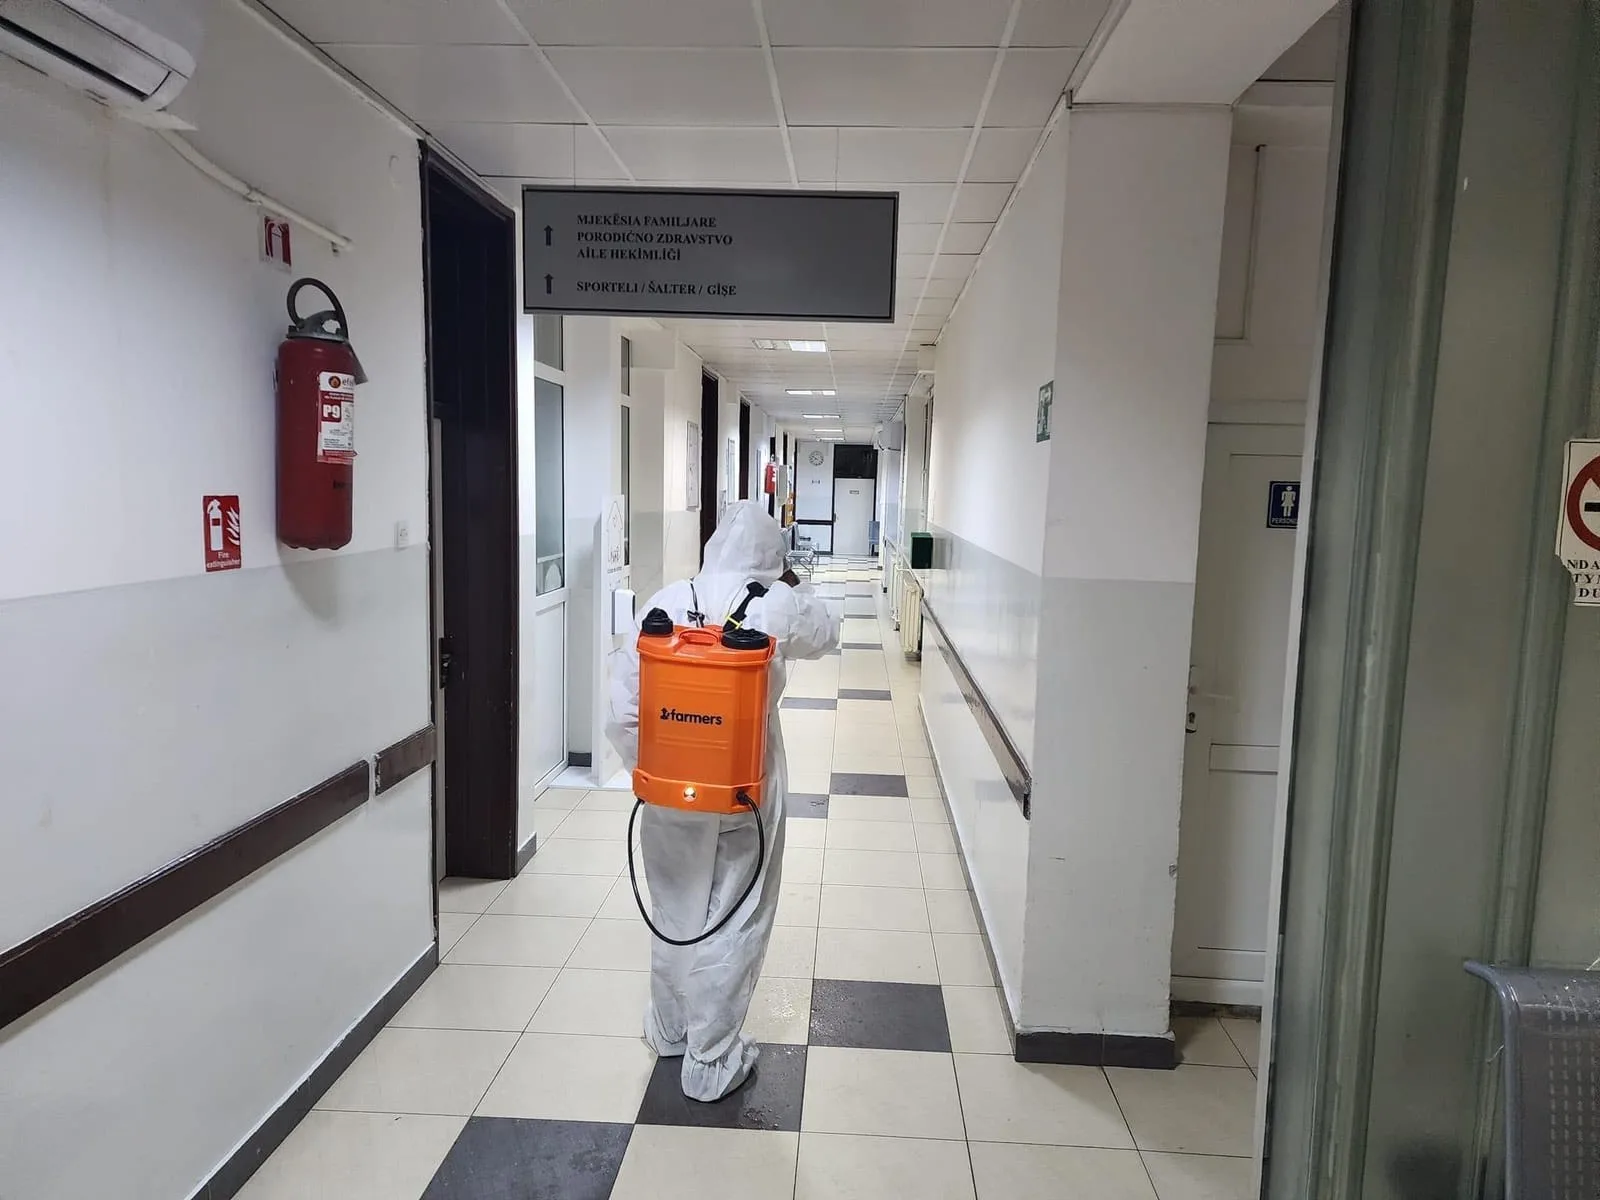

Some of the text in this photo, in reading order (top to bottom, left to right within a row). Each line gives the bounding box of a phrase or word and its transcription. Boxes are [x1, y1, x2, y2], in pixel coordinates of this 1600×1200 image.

[577, 213, 717, 228] MJEKËSIA FAMILJARE
[656, 233, 733, 245] ZDRAVSTVO
[577, 281, 638, 293] SPORTELI
[648, 281, 696, 295] ŠALTER
[322, 404, 341, 419] P9
[218, 551, 230, 559] Fire
[206, 559, 241, 569] extinguisher
[671, 709, 722, 725] farmers
